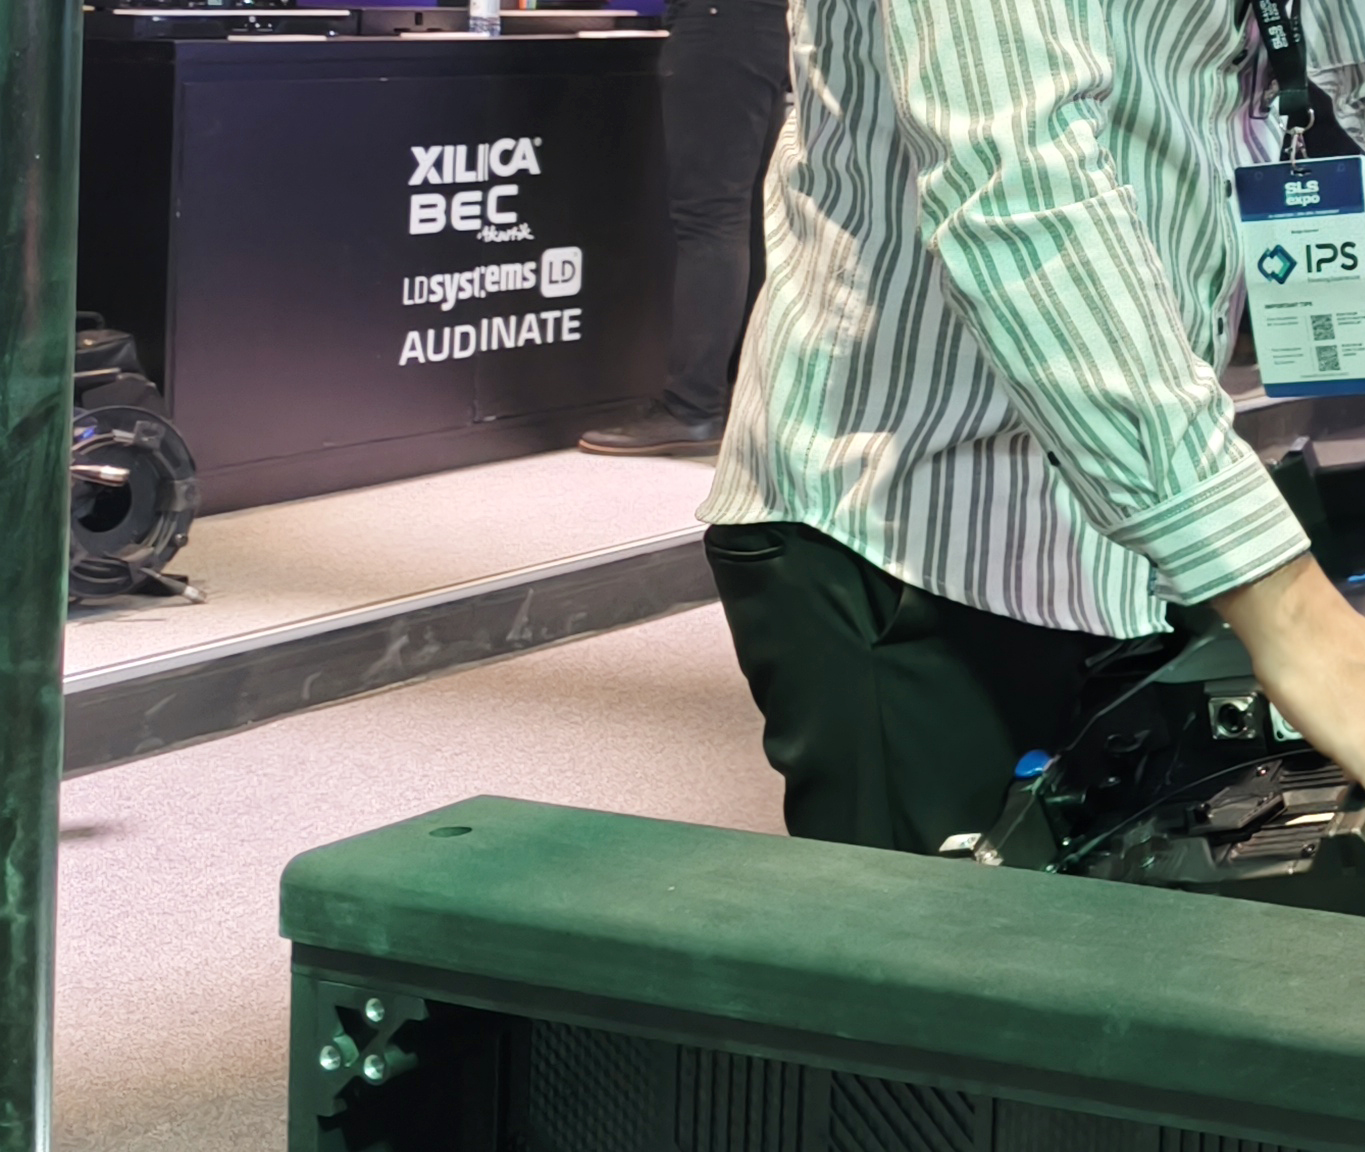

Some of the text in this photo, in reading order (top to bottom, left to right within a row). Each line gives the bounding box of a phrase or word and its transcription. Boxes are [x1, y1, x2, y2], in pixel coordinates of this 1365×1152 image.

[408, 137, 541, 185] XILICA
[1284, 180, 1320, 194] SLS
[1286, 194, 1320, 207] expo
[409, 184, 519, 235] BEC
[549, 260, 576, 284] LD
[1306, 241, 1358, 273] IPS
[399, 308, 582, 366] AUDINATE
